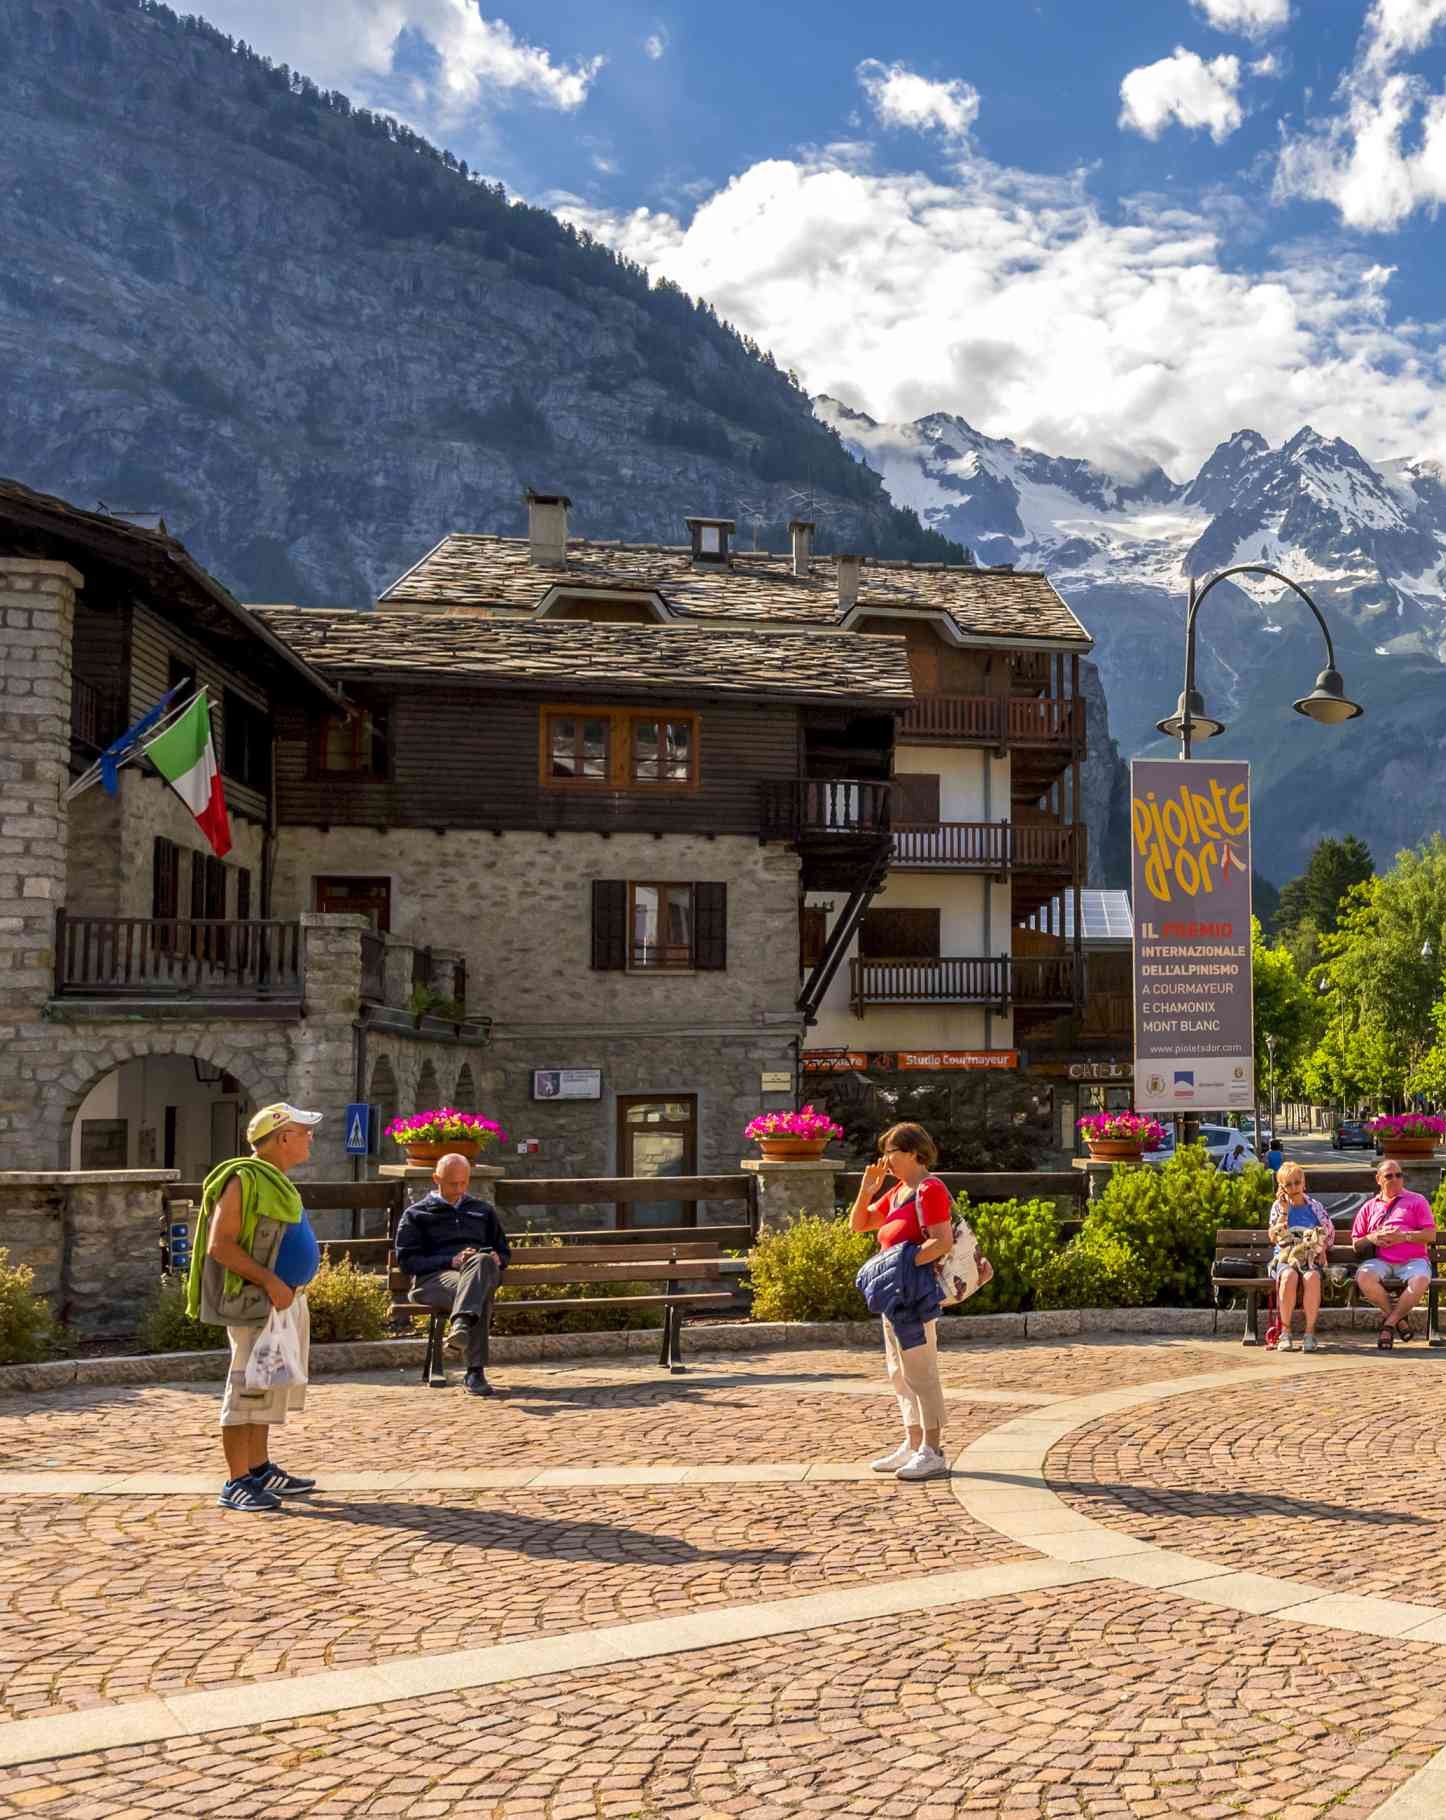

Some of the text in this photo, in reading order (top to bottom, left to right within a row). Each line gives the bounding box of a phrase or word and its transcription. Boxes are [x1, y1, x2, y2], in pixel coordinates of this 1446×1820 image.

[1142, 922, 1159, 939] IL
[1141, 945, 1246, 958] INTERNAZIONALE
[1142, 964, 1239, 977] DELL'ALPINISMO
[1142, 982, 1234, 995] A COURMAYEUR
[1143, 1001, 1216, 1014] E CHAMONIX
[1143, 1019, 1221, 1033] MONT BLANC
[906, 1055, 1009, 1066] Studio Courmayeur
